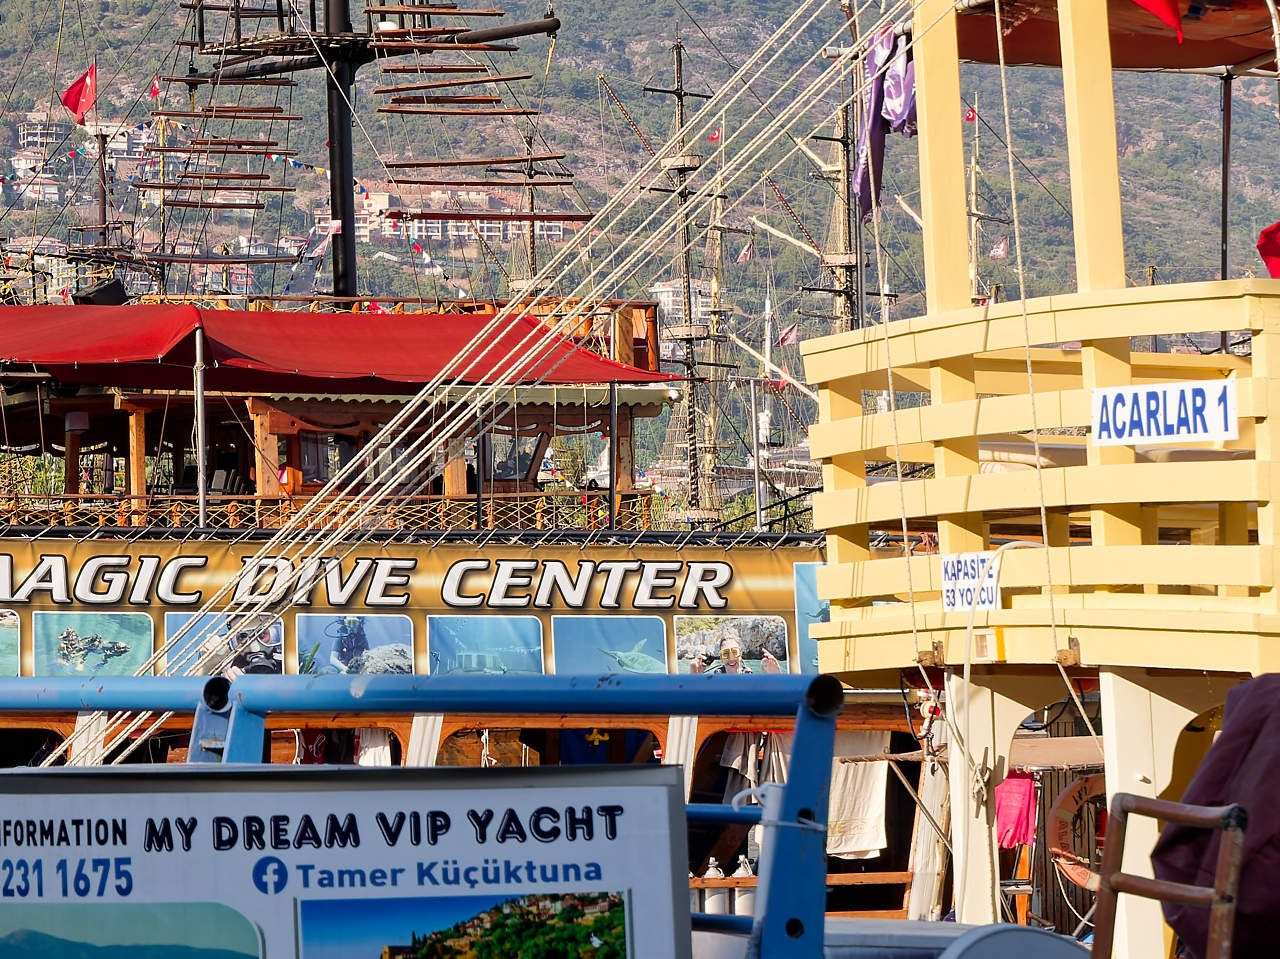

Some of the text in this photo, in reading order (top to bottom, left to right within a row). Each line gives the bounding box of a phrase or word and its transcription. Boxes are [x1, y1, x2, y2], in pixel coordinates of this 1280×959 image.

[1097, 384, 1230, 440] ACARLAR 1
[231, 554, 418, 607] DIVE
[438, 558, 733, 610] CENTER
[945, 587, 994, 607] 53 YOCU
[143, 804, 625, 853] MY DREAM VIP YACHT
[1, 857, 44, 898] 231
[56, 856, 134, 898] 1675
[295, 858, 603, 891] Tamer Küçüktuna
